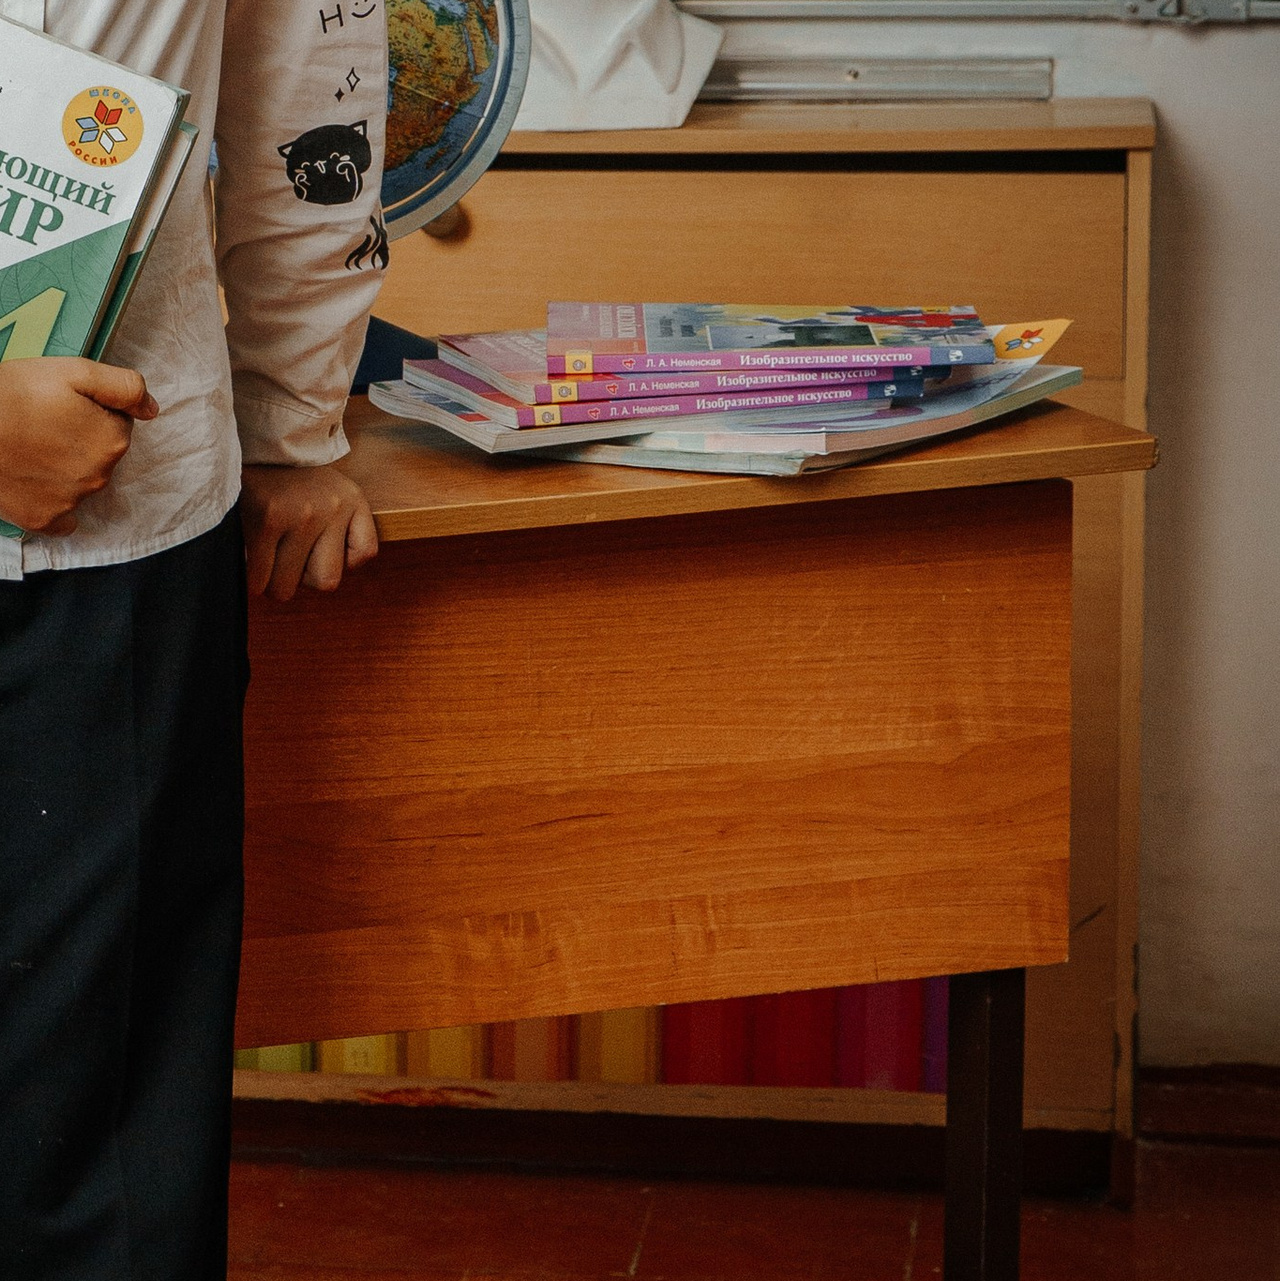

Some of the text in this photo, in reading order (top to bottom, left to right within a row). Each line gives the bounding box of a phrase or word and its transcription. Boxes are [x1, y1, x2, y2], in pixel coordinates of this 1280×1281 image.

[68, 140, 118, 166] РОССИИ
[646, 358, 656, 368] Л.
[658, 358, 668, 367] А.
[670, 358, 722, 367] Неменская
[740, 354, 848, 368] Изобразительное
[851, 352, 913, 365] искусство
[628, 382, 638, 392] Л.
[640, 382, 650, 391] А.
[651, 380, 700, 390] Неменская
[717, 372, 818, 388] Изобразительное
[821, 369, 877, 382] искусство
[610, 407, 619, 416] Л.
[621, 406, 630, 415] А.
[632, 404, 680, 414] Неменская
[696, 394, 794, 410] Изобразительное
[797, 389, 852, 403] искусство
